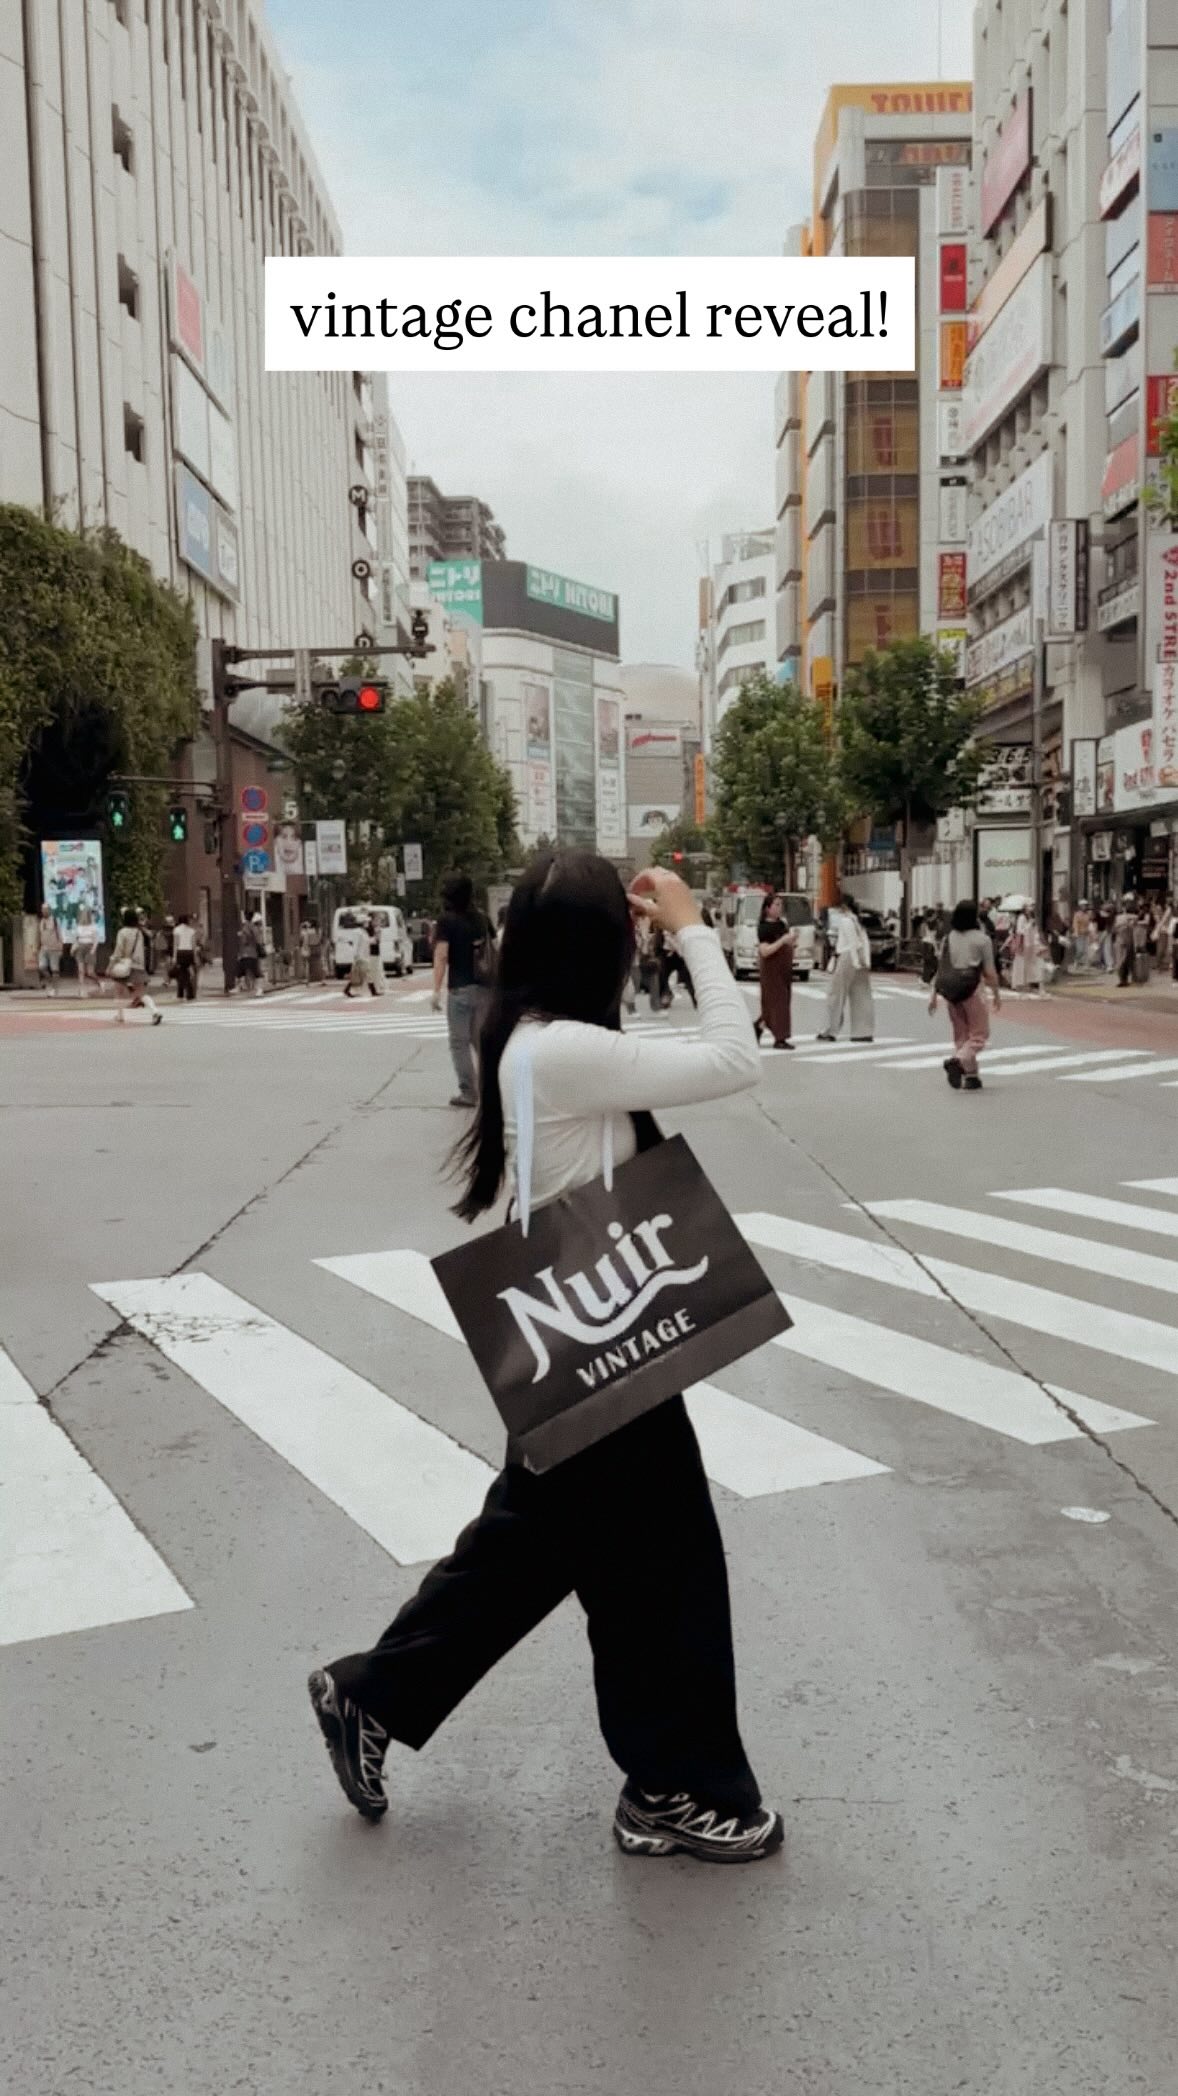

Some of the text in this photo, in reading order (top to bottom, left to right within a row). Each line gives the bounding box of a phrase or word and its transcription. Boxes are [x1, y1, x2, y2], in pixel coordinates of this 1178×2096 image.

[284, 801, 299, 820] 5
[496, 1213, 709, 1384] Nuir
[576, 1308, 697, 1388] VINTAGE
